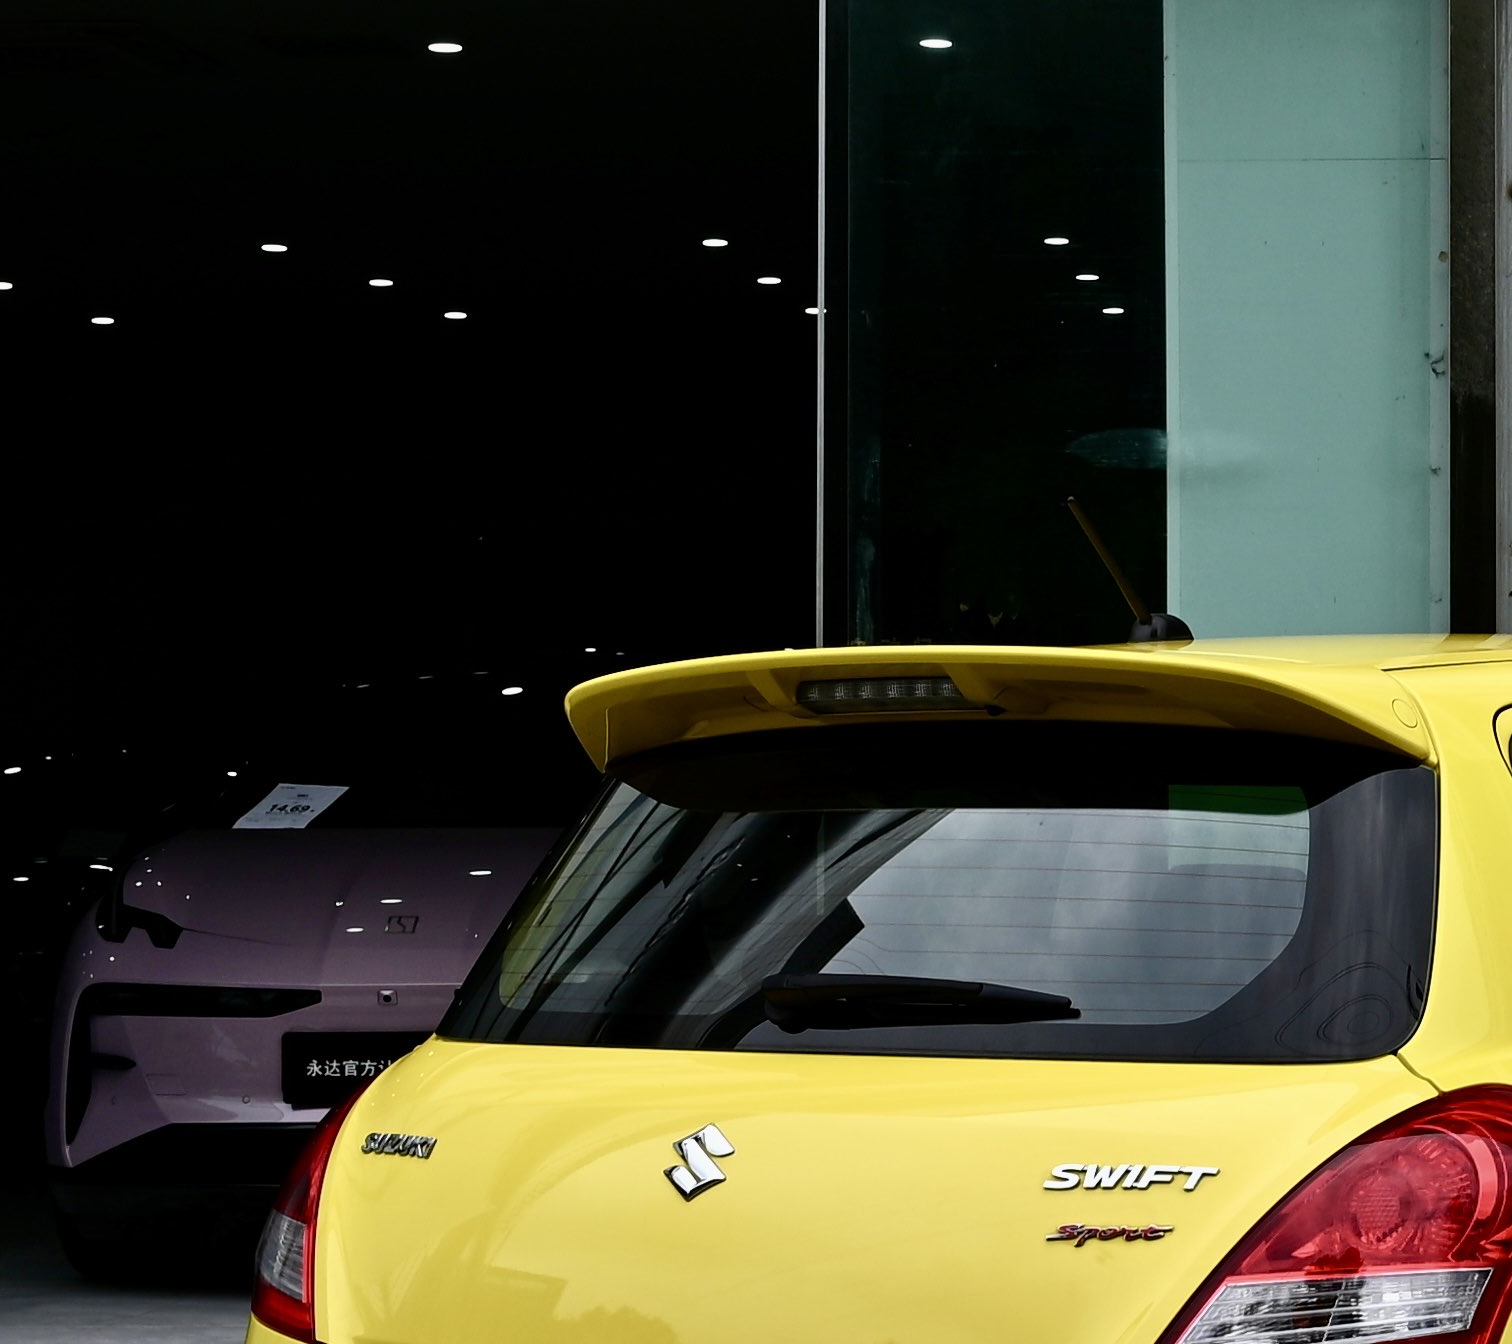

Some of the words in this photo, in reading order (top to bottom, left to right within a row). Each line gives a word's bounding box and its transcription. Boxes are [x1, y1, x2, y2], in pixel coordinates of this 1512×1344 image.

[361, 1132, 437, 1160] SUZUKI
[1042, 1163, 1220, 1192] SWIFT
[1045, 1223, 1174, 1247] Sport
